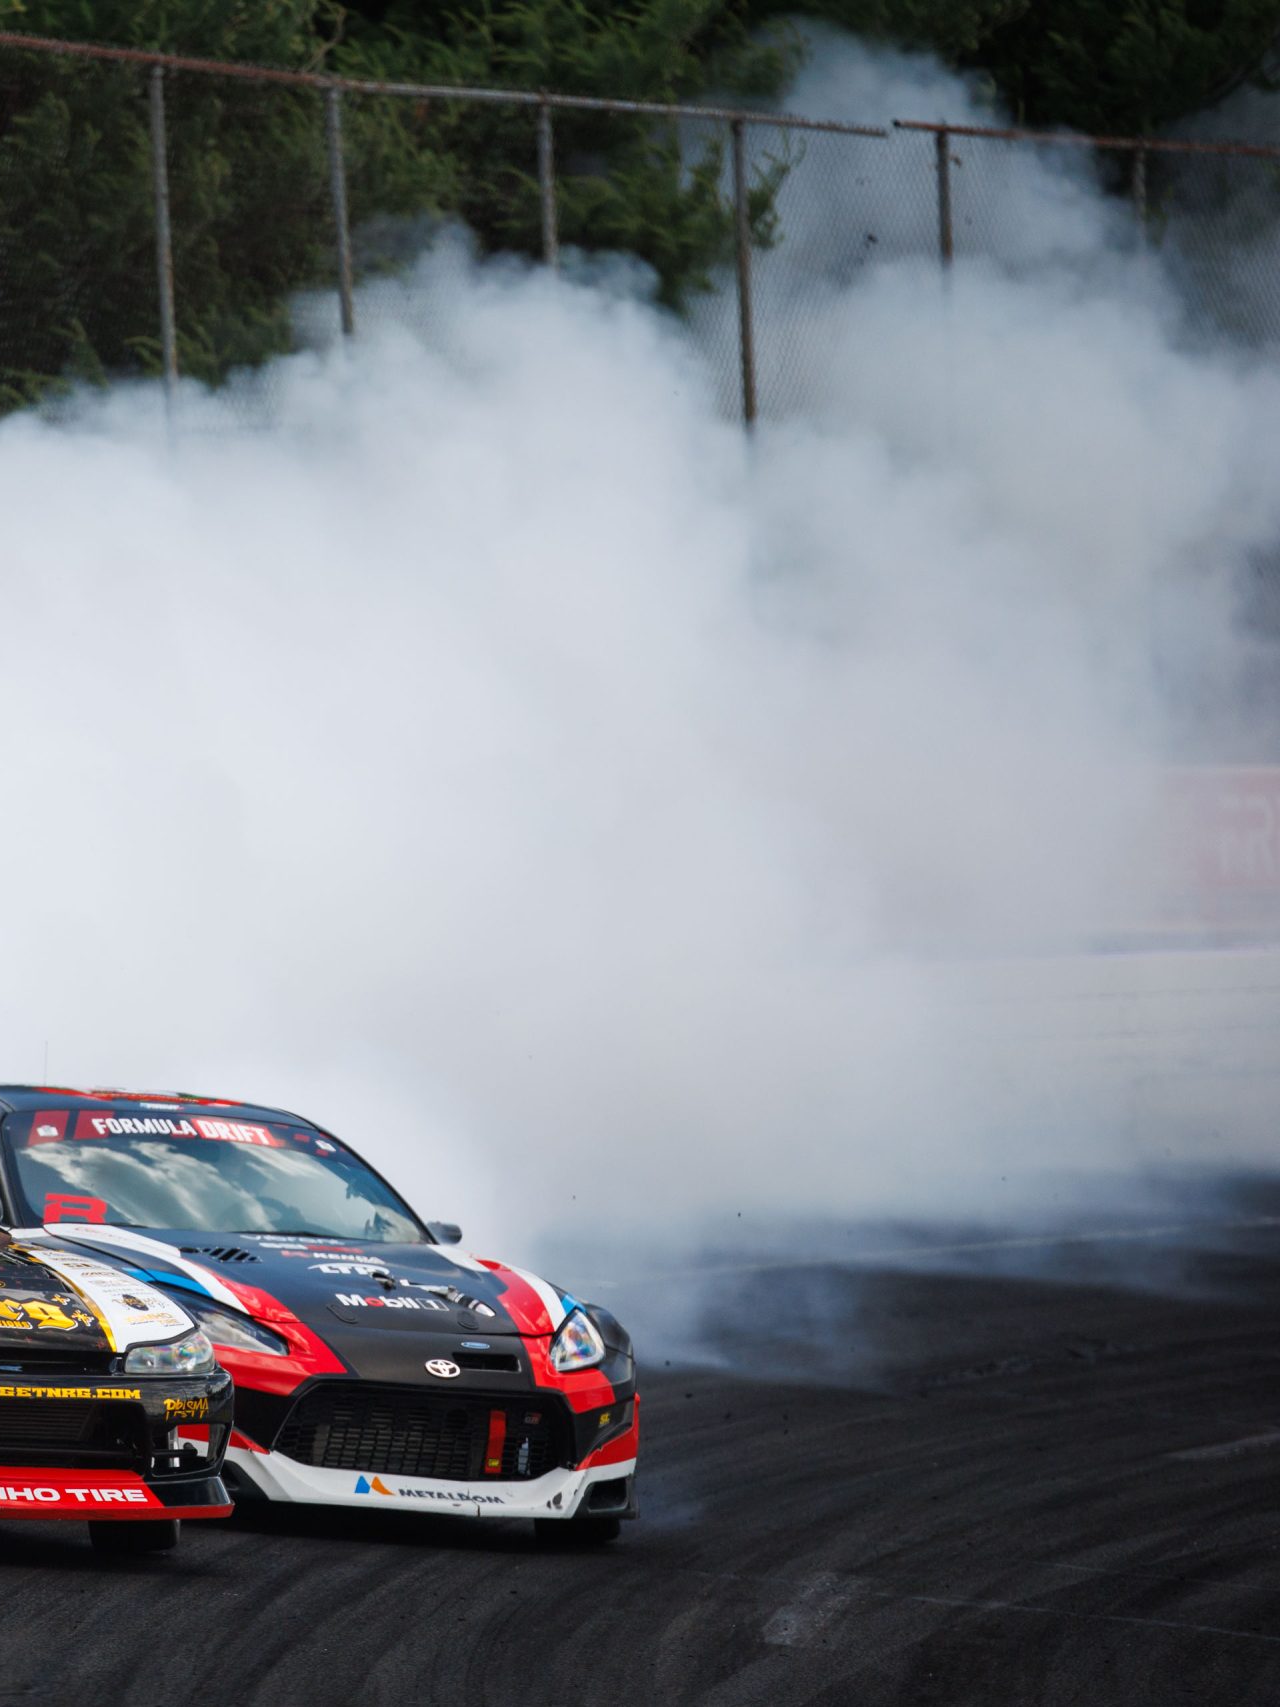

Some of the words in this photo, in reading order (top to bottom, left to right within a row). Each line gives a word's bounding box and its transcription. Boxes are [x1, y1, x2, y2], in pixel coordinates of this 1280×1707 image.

[91, 1117, 200, 1137] FORMULA
[196, 1118, 270, 1145] DRIFT
[335, 1293, 420, 1310] Mobil
[65, 1488, 149, 1503] TIRE
[398, 1488, 505, 1504] METALDOM
